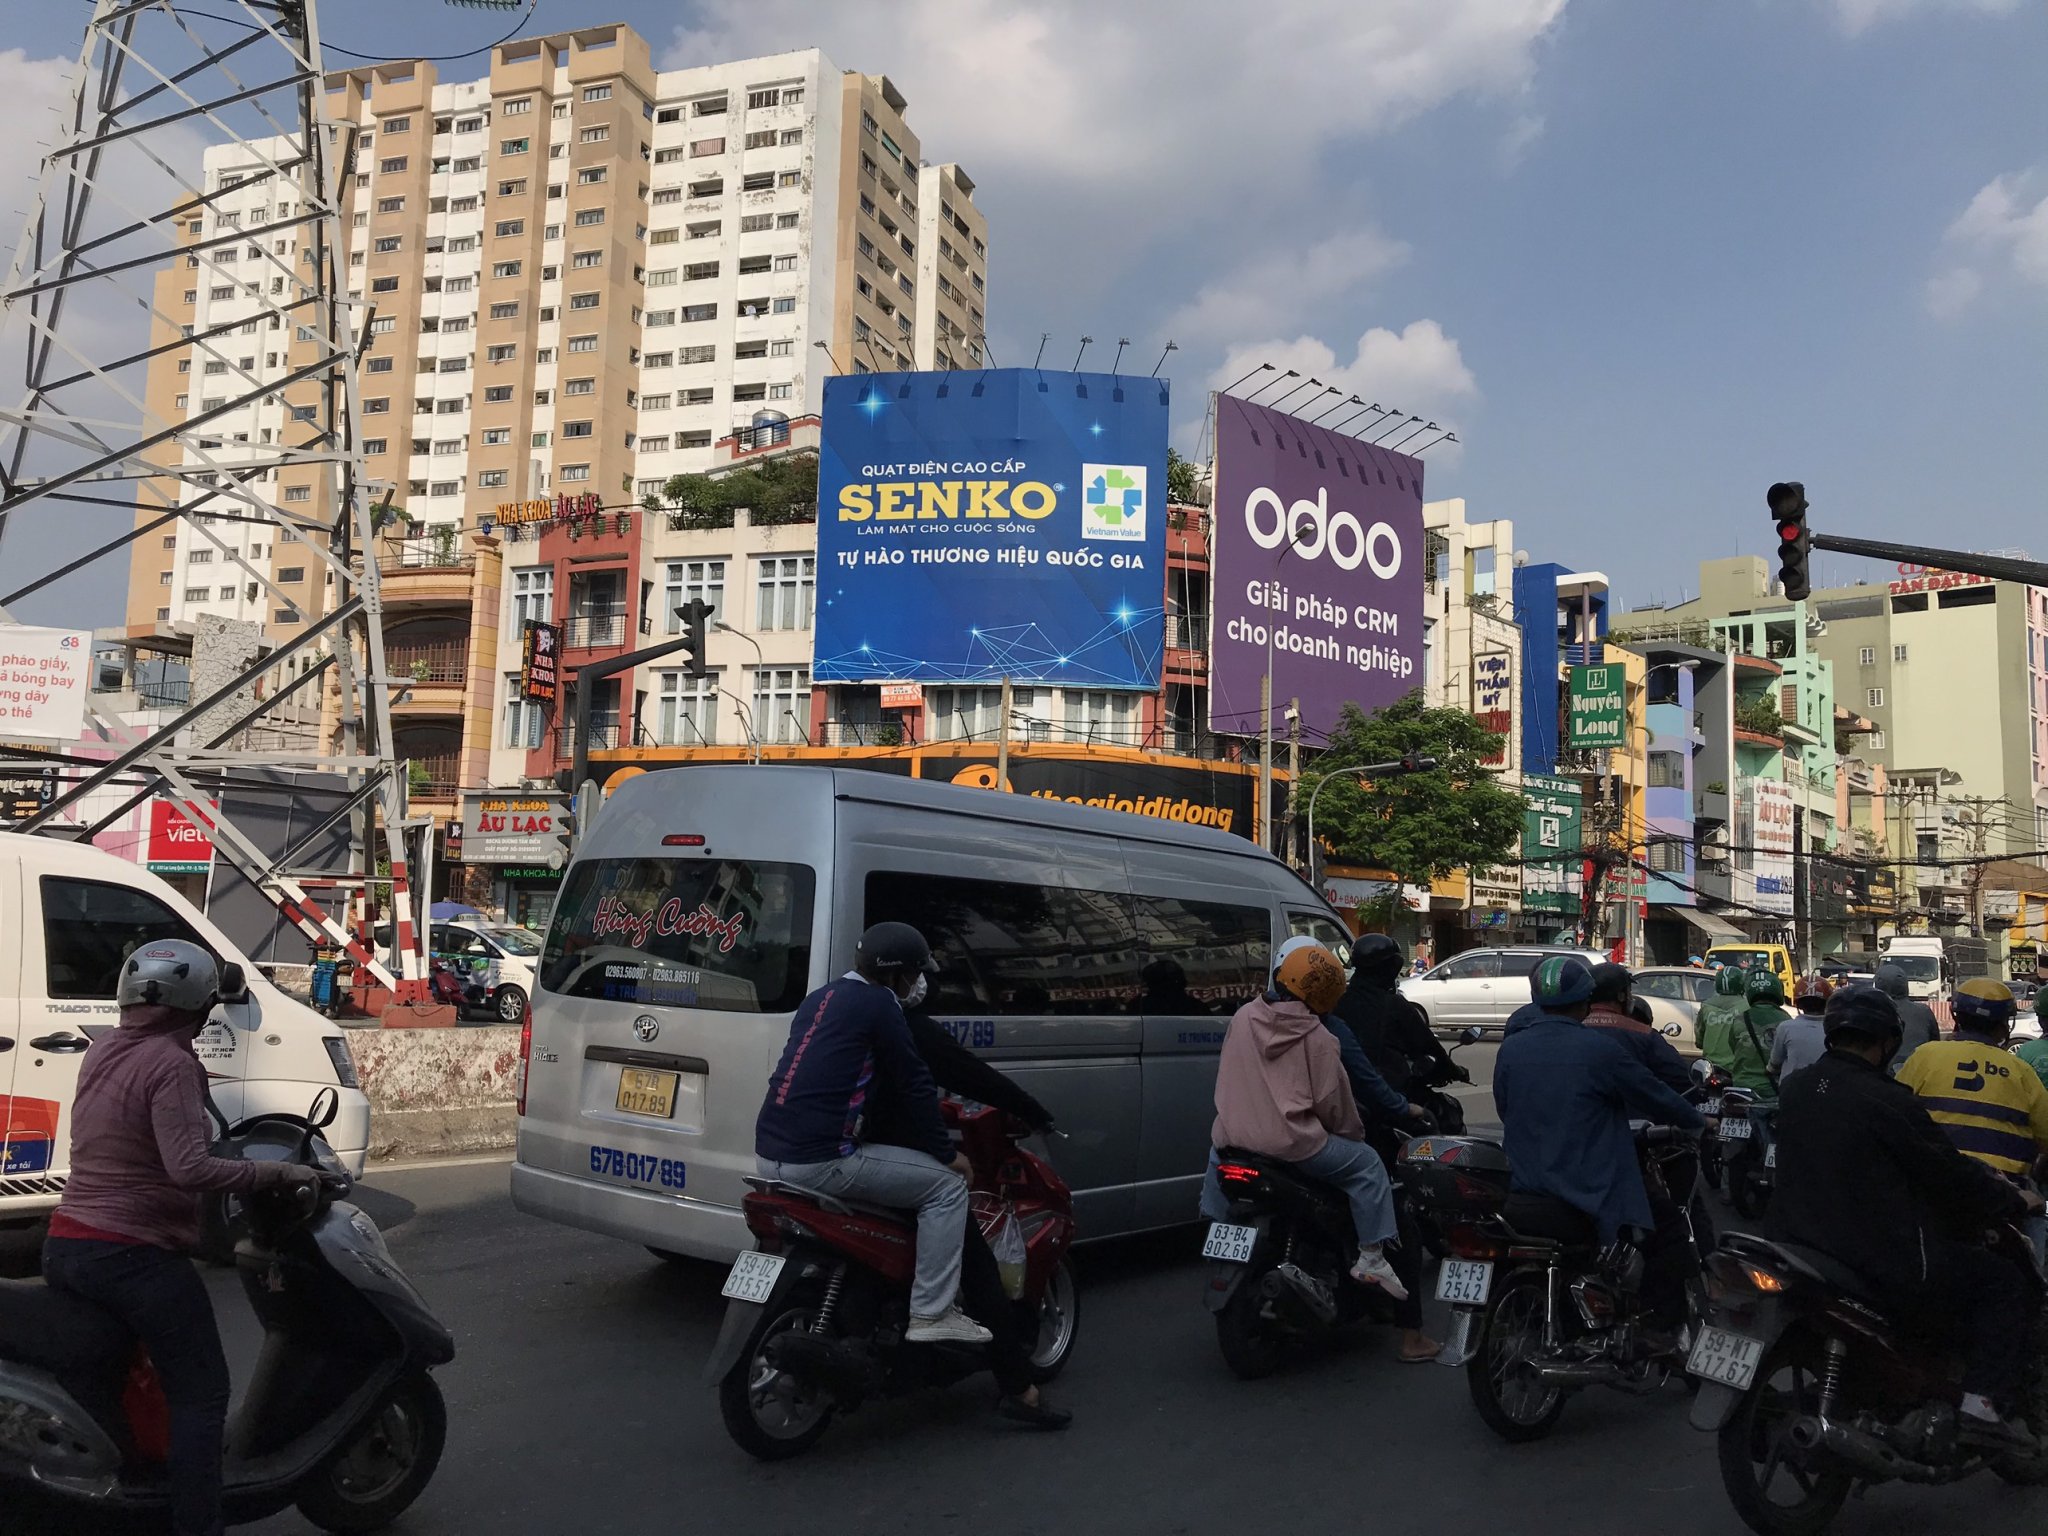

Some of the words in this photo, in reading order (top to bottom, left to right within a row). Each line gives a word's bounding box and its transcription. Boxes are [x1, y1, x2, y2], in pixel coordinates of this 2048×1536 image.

[862, 463, 906, 478] QUẠT
[909, 460, 948, 477] ĐIỆN
[951, 461, 988, 474] CAO
[990, 457, 1026, 473] CẤP
[838, 480, 1057, 522] SENKO
[495, 502, 519, 525] NHA
[522, 498, 553, 522] KHOA
[920, 523, 950, 533] CHO
[953, 522, 993, 534] CUỘC
[1086, 526, 1119, 536] Vietnam
[1120, 528, 1141, 537] Value
[1244, 486, 1402, 580] odoo
[837, 549, 859, 570] TỰ
[864, 546, 905, 565] HÀO
[911, 546, 990, 564] THƯƠNG
[997, 545, 1039, 567] HIỆU
[1045, 546, 1104, 567] QUỐC
[1110, 553, 1145, 569] GIA
[1888, 578, 1923, 595] TÂN
[1246, 580, 1289, 612] Giải
[1295, 593, 1348, 629] pháp
[1353, 605, 1398, 636] CRM
[1226, 616, 1268, 646] cho
[1273, 625, 1340, 661] doanh
[1346, 644, 1413, 679] nghiệp
[12, 671, 47, 687] bóng
[50, 674, 75, 689] bay
[1575, 717, 1619, 737] Long
[479, 799, 508, 812] NHA
[477, 812, 507, 833] ÂU
[512, 815, 553, 837] LẠC
[503, 869, 521, 878] NHA
[523, 869, 547, 878] KHOA
[592, 895, 654, 948] Hùng
[656, 896, 744, 953] Cường
[1750, 979, 1772, 988] Grab
[45, 1004, 92, 1014] THACO
[1984, 1060, 2010, 1078] be
[622, 1090, 666, 1114] 017.89
[1214, 1225, 1249, 1243] 63-B4
[1205, 1240, 1250, 1260] 902.68
[1447, 1262, 1486, 1282] 94-F3
[726, 1274, 771, 1299] 315.51
[1443, 1281, 1482, 1301] 2542
[1692, 1350, 1751, 1385] 417.67
